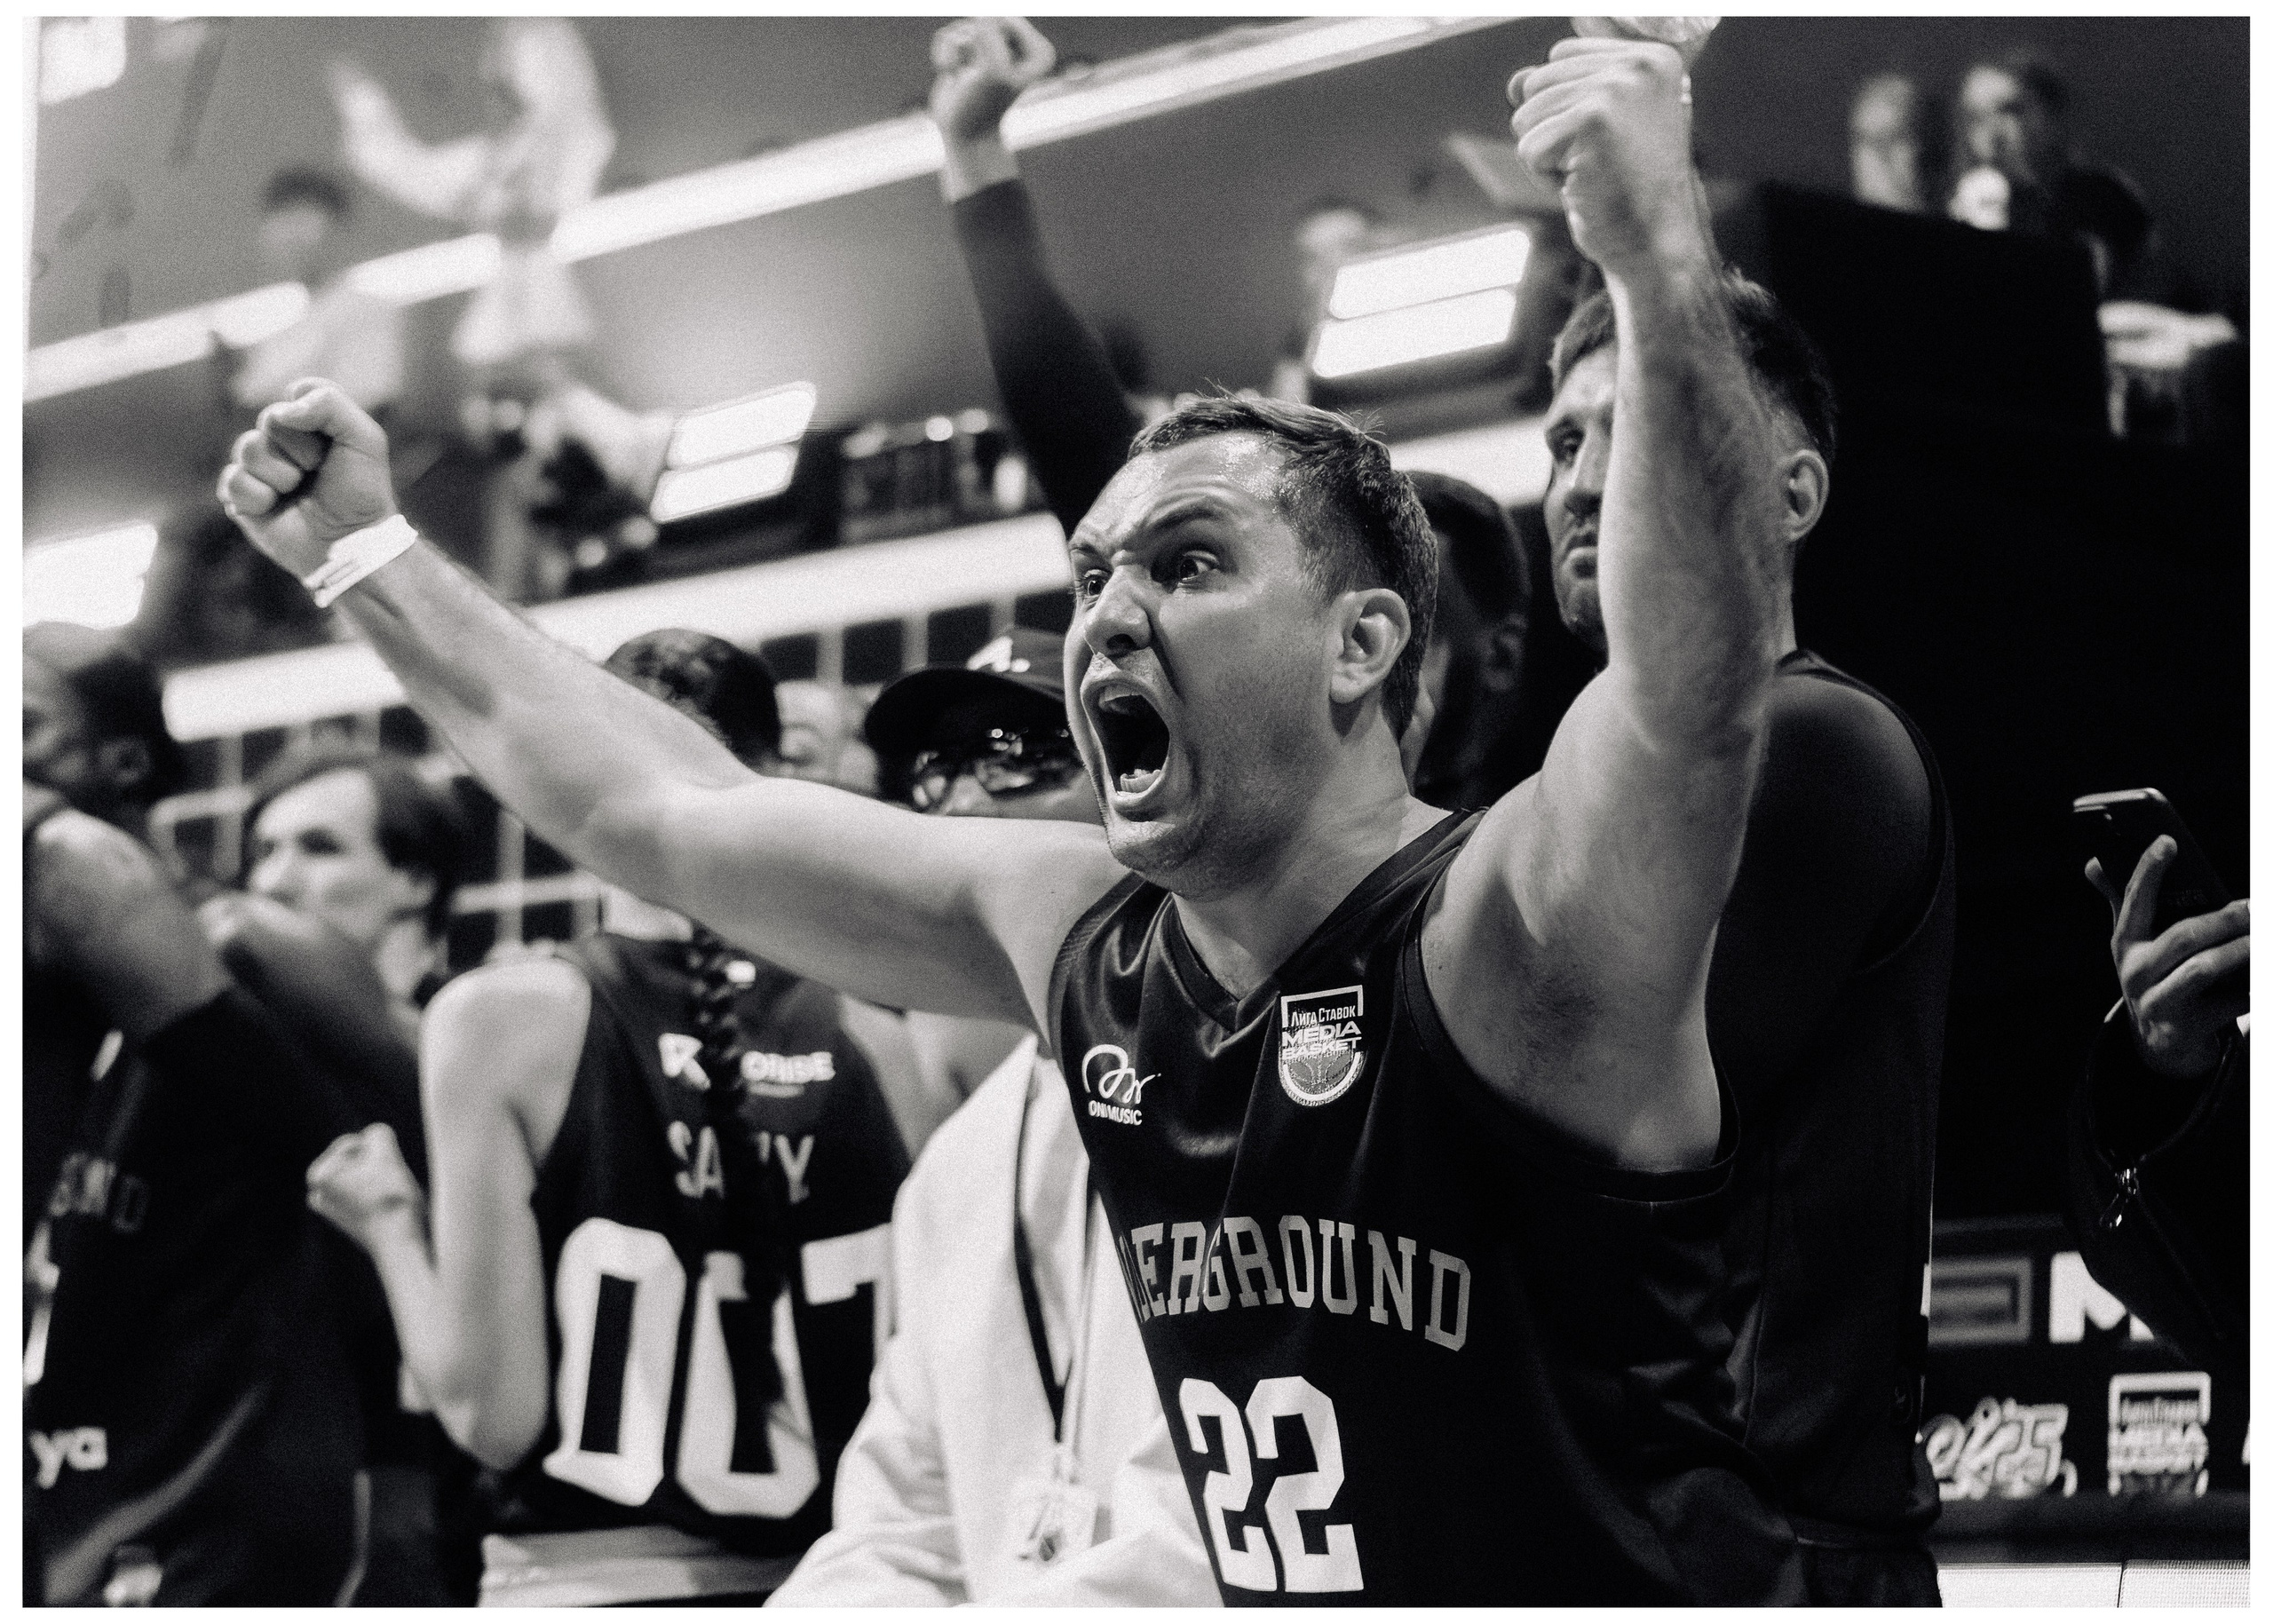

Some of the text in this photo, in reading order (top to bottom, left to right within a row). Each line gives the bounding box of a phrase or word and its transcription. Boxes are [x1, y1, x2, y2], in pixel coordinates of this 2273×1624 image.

[1281, 1020, 1362, 1048] MEDIA
[1282, 1036, 1362, 1060] BASKET
[1117, 1216, 1471, 1351] DERGROUND
[1179, 1375, 1364, 1593] 22
